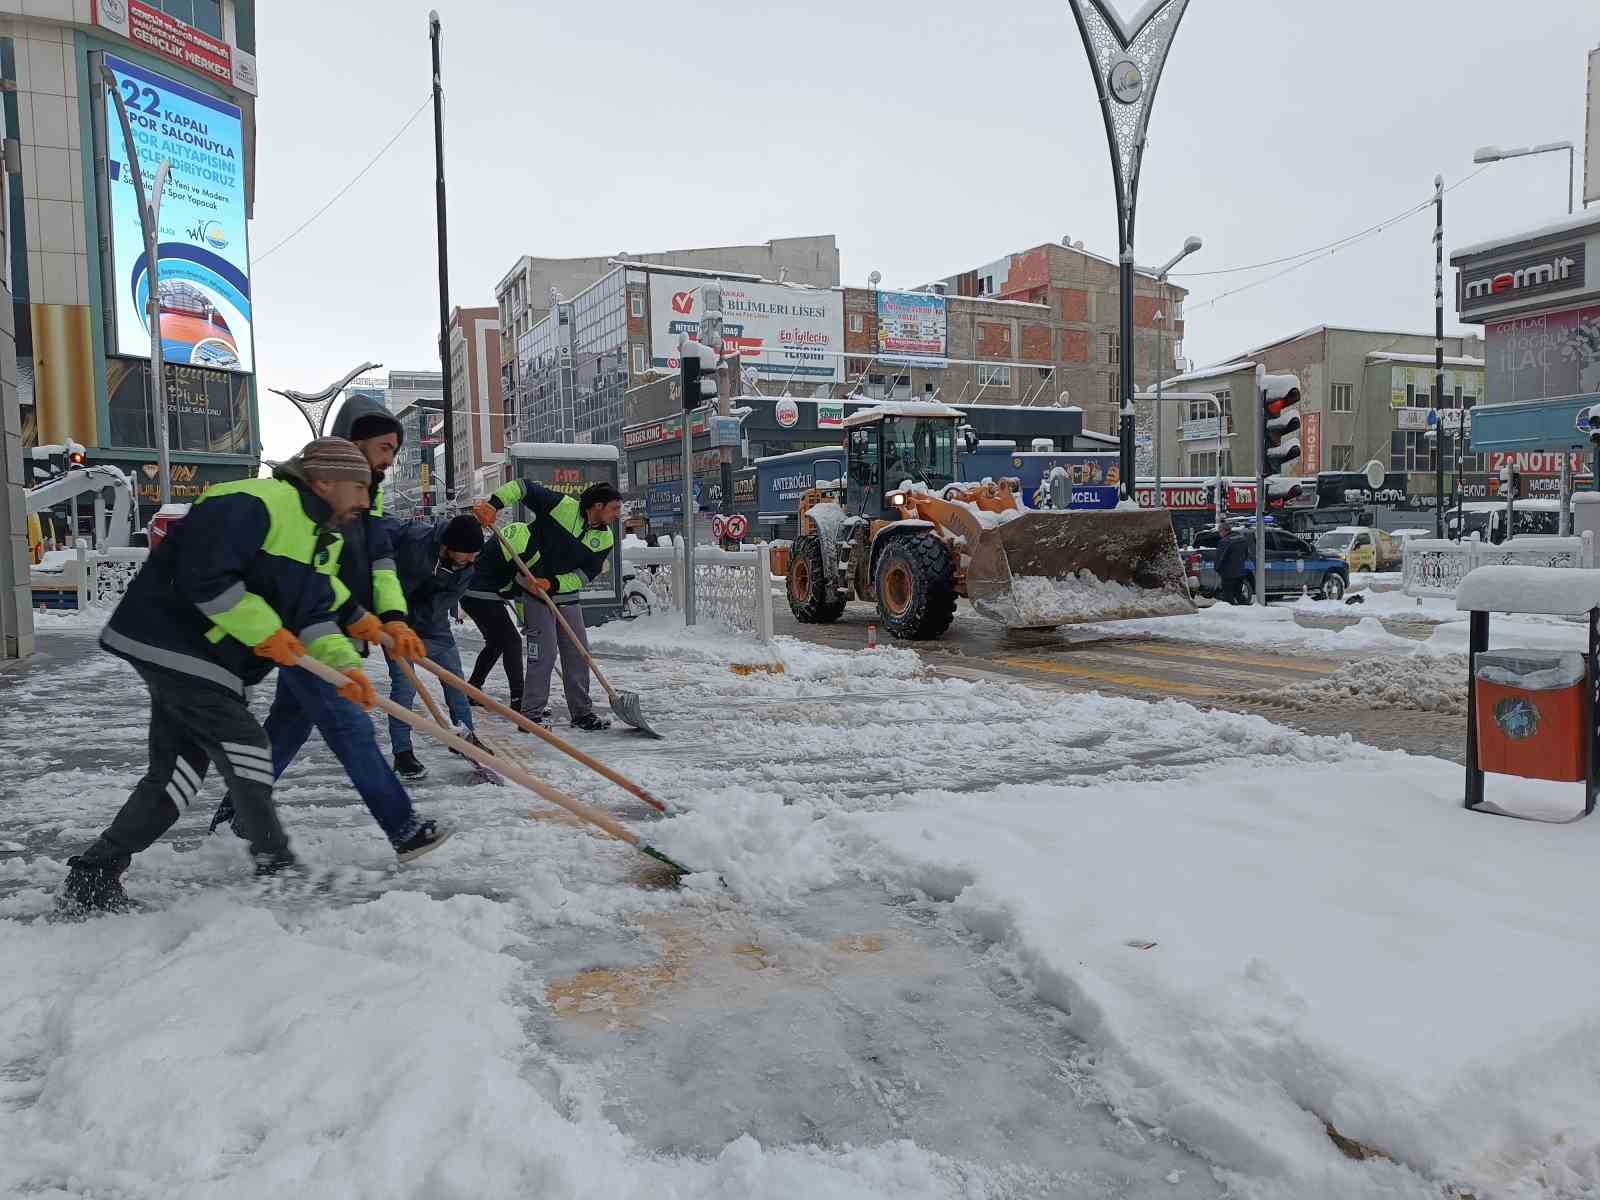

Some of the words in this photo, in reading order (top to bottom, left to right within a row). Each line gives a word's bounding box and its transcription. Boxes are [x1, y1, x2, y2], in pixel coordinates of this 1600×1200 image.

[133, 27, 183, 59] GENÇLİK
[121, 79, 160, 118] 22
[164, 110, 208, 136] KAPALI
[161, 123, 235, 159] SALONUYLA
[168, 187, 185, 200] Spor
[187, 194, 217, 210] Yapacak
[728, 300, 788, 315] BİLİMLERİ
[792, 306, 826, 318] LİSESİ
[1071, 491, 1101, 503] KCELL
